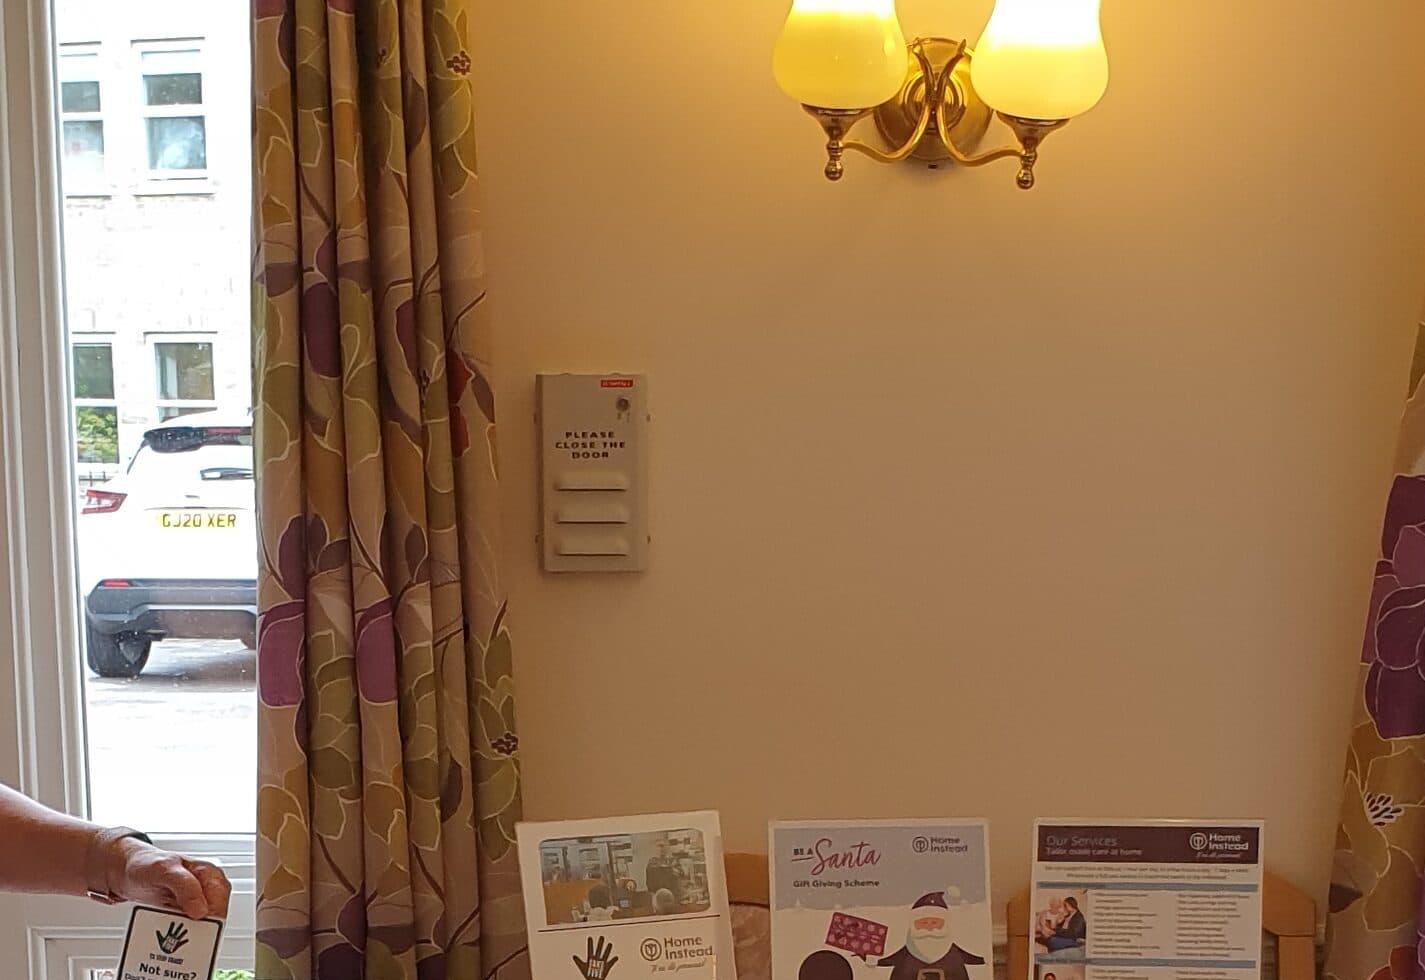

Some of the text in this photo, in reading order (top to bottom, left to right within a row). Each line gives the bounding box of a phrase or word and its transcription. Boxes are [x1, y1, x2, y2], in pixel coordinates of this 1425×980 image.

[565, 431, 615, 439] PLEASE
[555, 441, 626, 450] CLOSE THE
[571, 451, 609, 460] DOOR
[162, 513, 237, 528] GJ20 XER
[931, 836, 960, 844] Home
[1046, 835, 1118, 847] Our Services
[1209, 834, 1241, 842] Home
[931, 845, 968, 853] Instead
[1209, 843, 1249, 851] Instead
[811, 838, 881, 876] Santa
[793, 879, 880, 889] Gift Giving Scheme
[664, 937, 702, 947] Home
[665, 946, 713, 960] Instead
[139, 963, 197, 980] Not sure?
